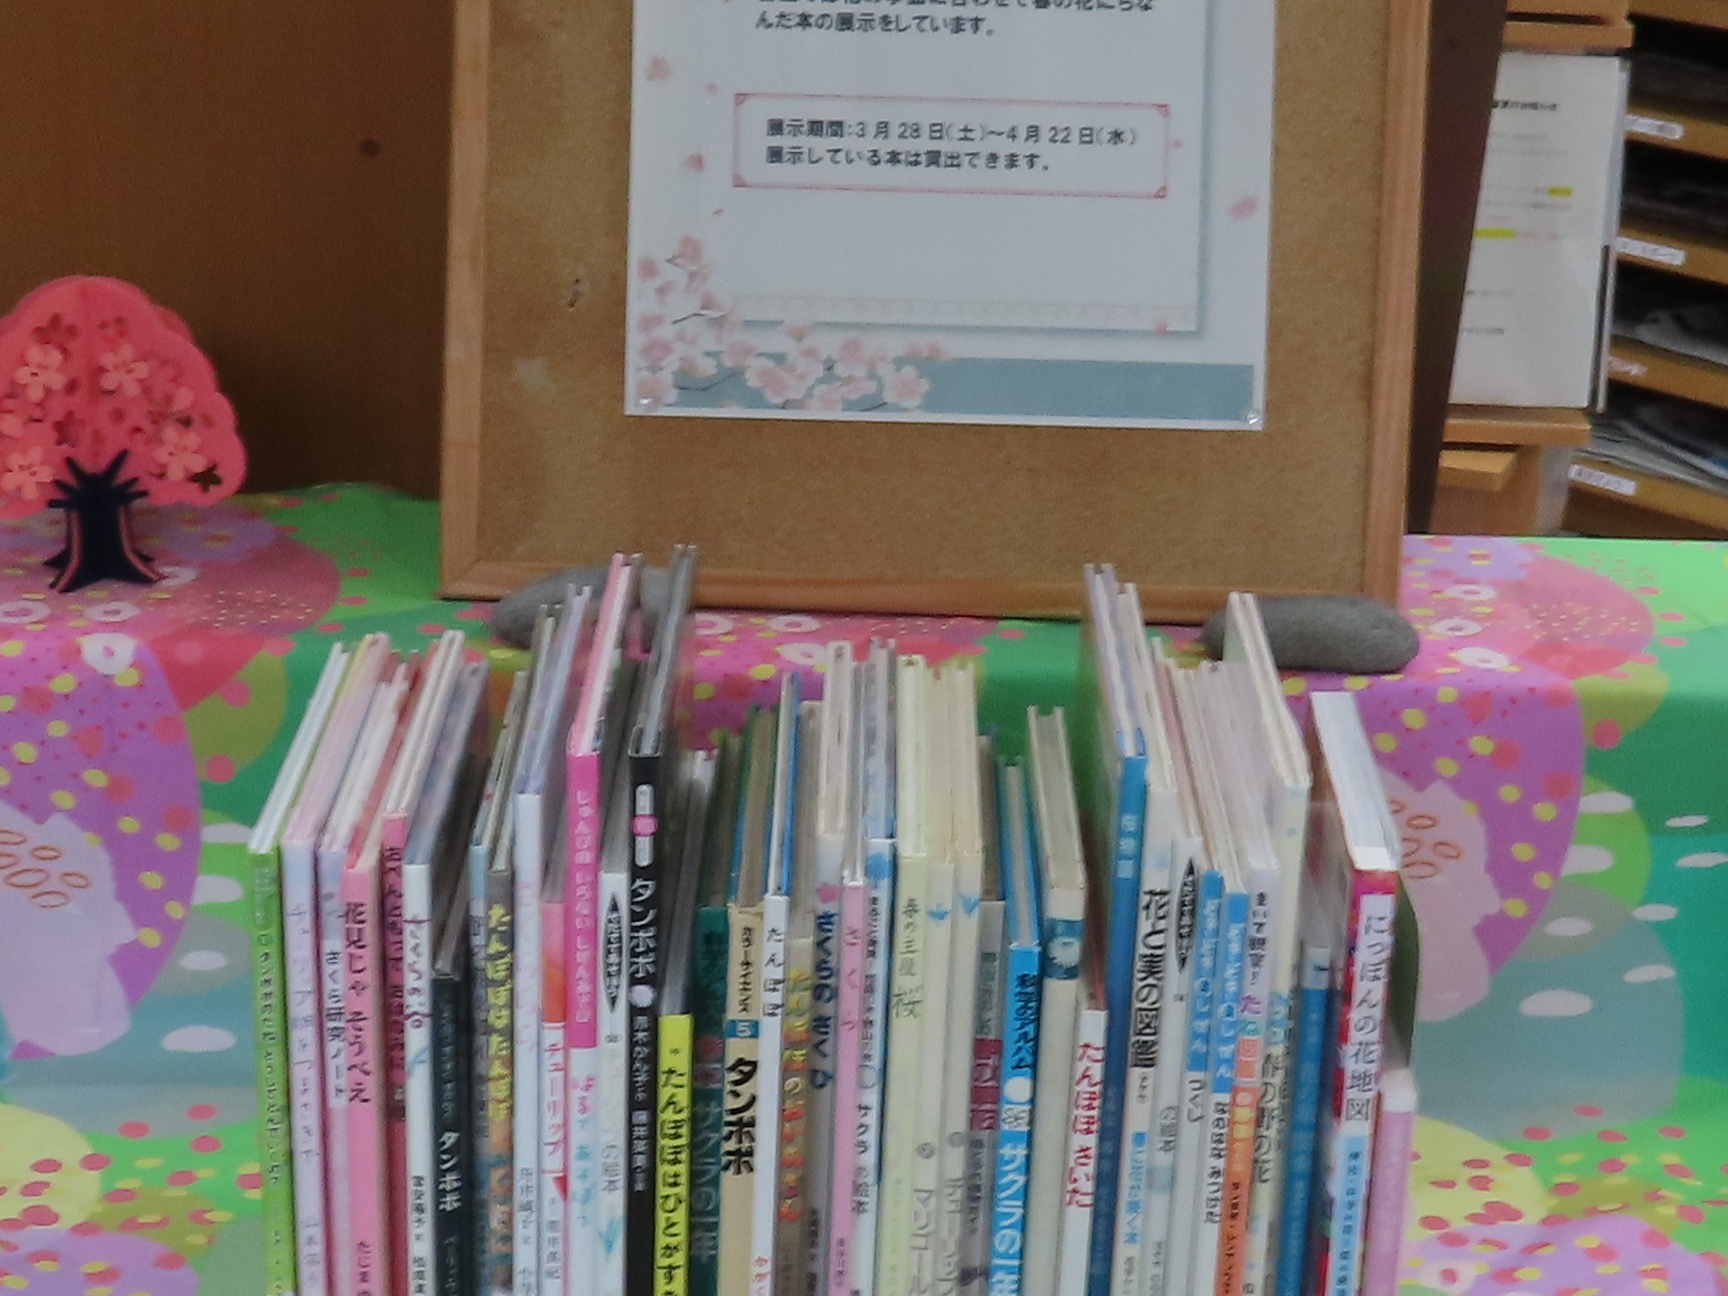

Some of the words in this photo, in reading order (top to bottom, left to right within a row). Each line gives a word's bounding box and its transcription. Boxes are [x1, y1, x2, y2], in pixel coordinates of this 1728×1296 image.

[755, 8, 995, 39] んだ本の展示をしています。
[765, 144, 1050, 172] 展示している本は貸出できます。
[628, 876, 657, 979] タンポポ
[761, 926, 785, 1018] たんぽぽ
[1129, 888, 1173, 1068] 花と実の図鑑
[1345, 912, 1393, 1124] にっぽんの花地図
[721, 1056, 759, 1177] タンポポ
[1073, 1042, 1107, 1136] たんぽぽ
